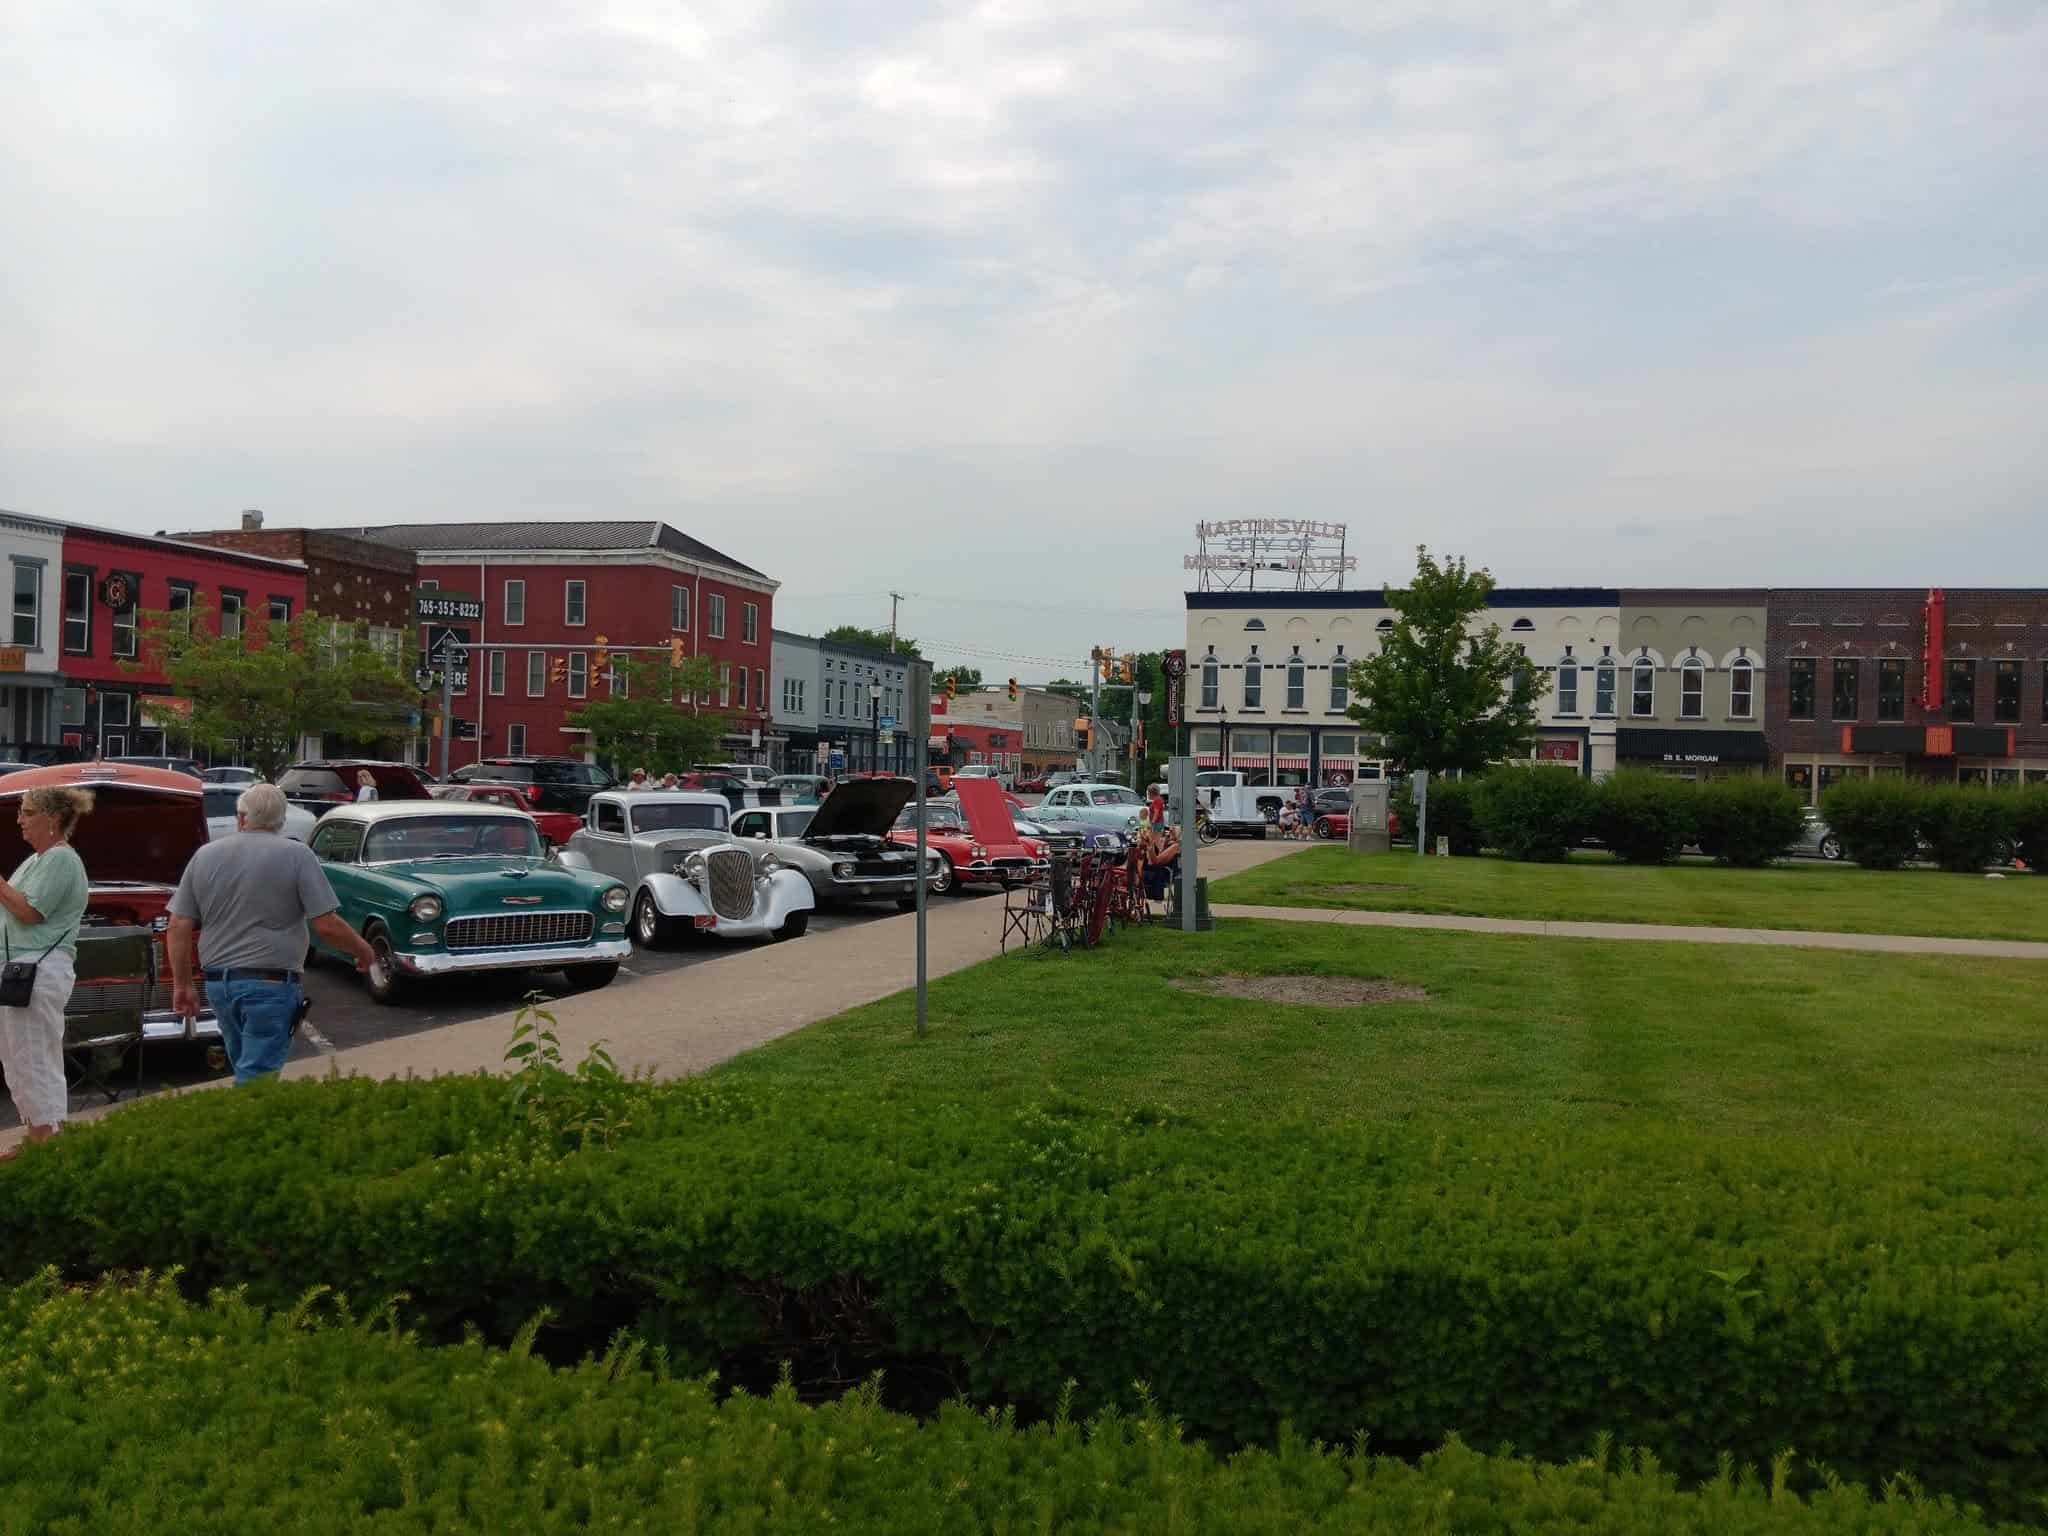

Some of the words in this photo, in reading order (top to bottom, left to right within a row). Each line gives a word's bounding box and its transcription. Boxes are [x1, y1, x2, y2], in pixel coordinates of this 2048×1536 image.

[1195, 518, 1346, 539] MARTINSVILLE
[1225, 537, 1273, 552] CITY
[1287, 537, 1315, 552] OF
[419, 600, 479, 617] 765-352-8222
